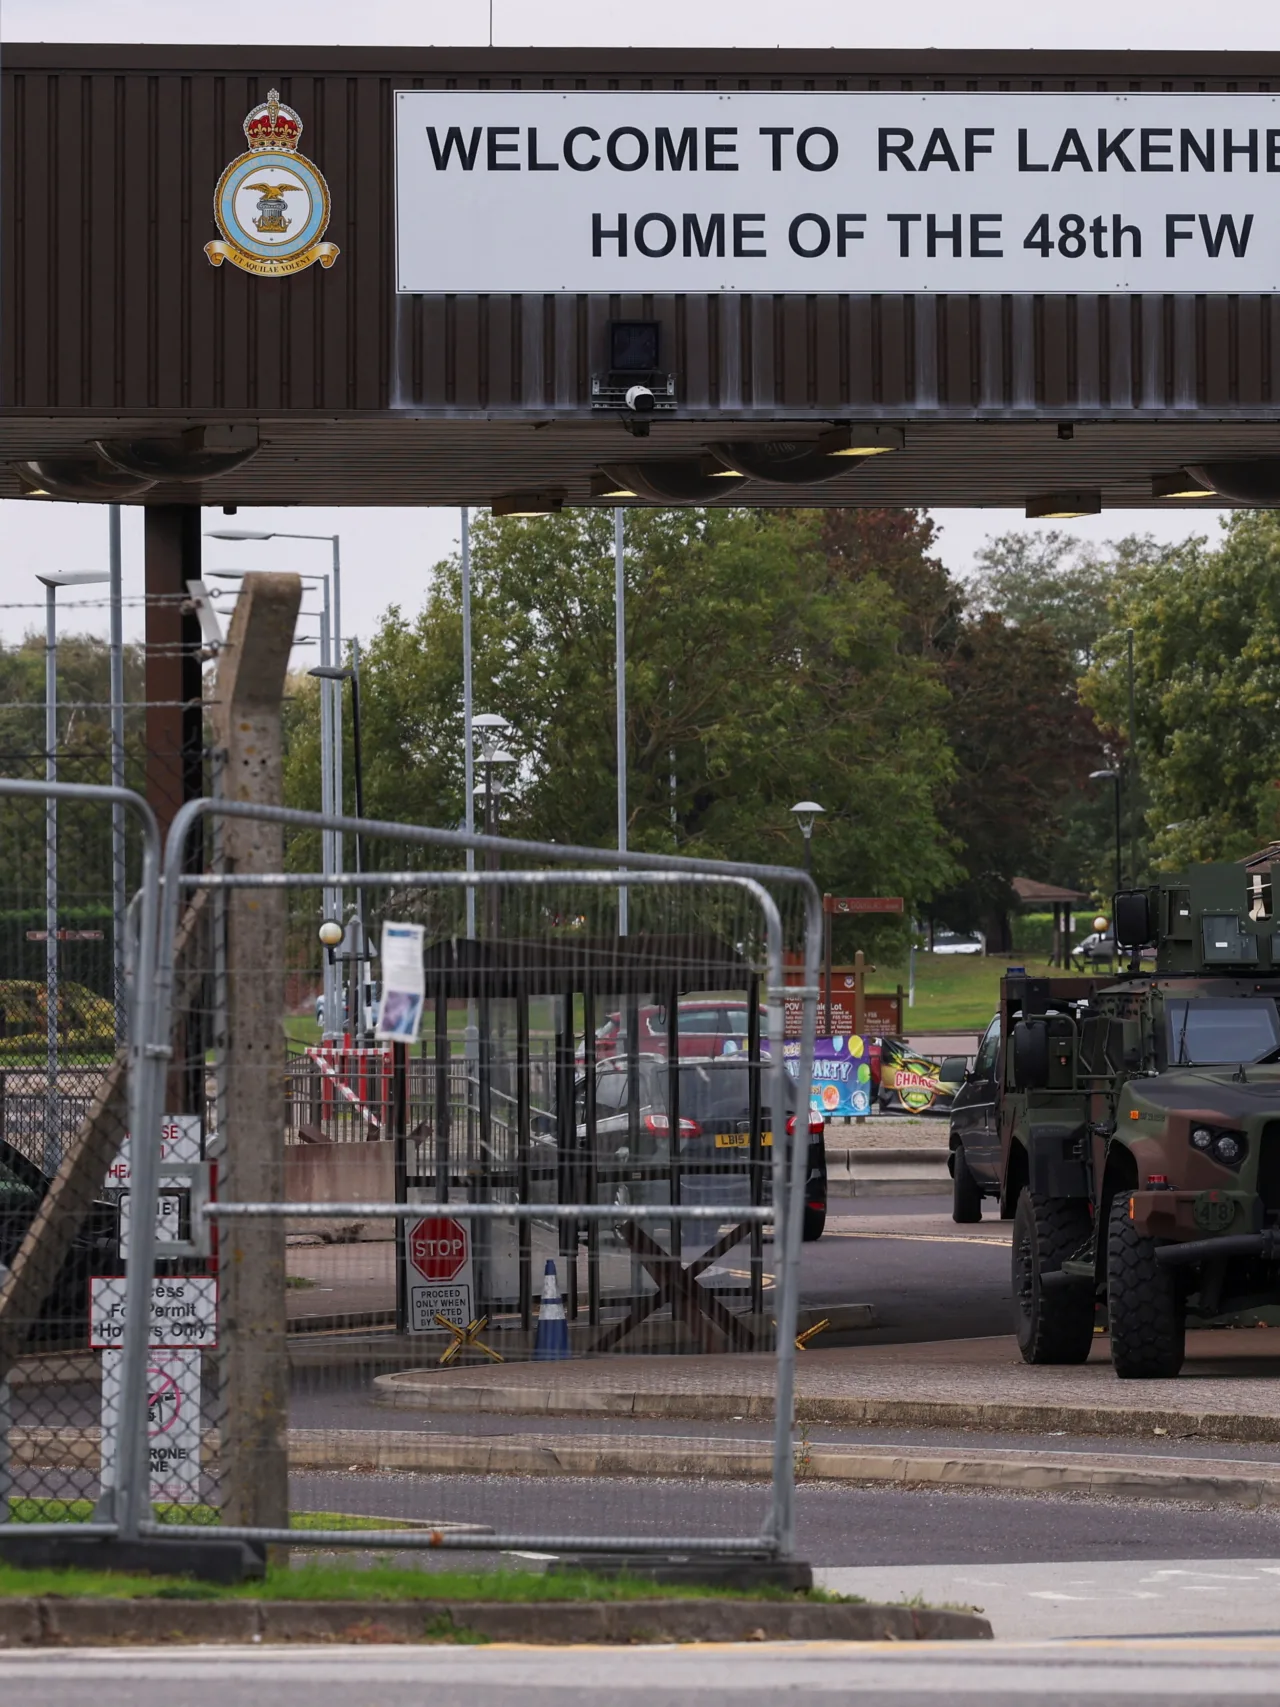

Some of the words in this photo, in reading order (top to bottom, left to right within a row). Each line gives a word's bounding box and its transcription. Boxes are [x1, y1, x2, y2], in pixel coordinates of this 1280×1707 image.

[425, 126, 739, 172] WELCOME
[759, 126, 839, 172] TO
[878, 126, 994, 172] RAF
[592, 212, 767, 258] HOME
[787, 212, 867, 258] OF
[887, 213, 1004, 258] THE
[1022, 213, 1142, 259] 48th
[1165, 213, 1254, 258] FW
[233, 254, 242, 264] UT
[244, 261, 279, 273] AQUILAE
[281, 256, 311, 272] VOLENT
[813, 1060, 852, 1081] ARTY
[415, 1238, 463, 1257] STOP
[416, 1300, 438, 1308] ONLY
[440, 1298, 466, 1307] WHEN
[421, 1289, 461, 1299] PROCEED
[420, 1308, 462, 1317] DIRECTED
[149, 1448, 186, 1459] RONE
